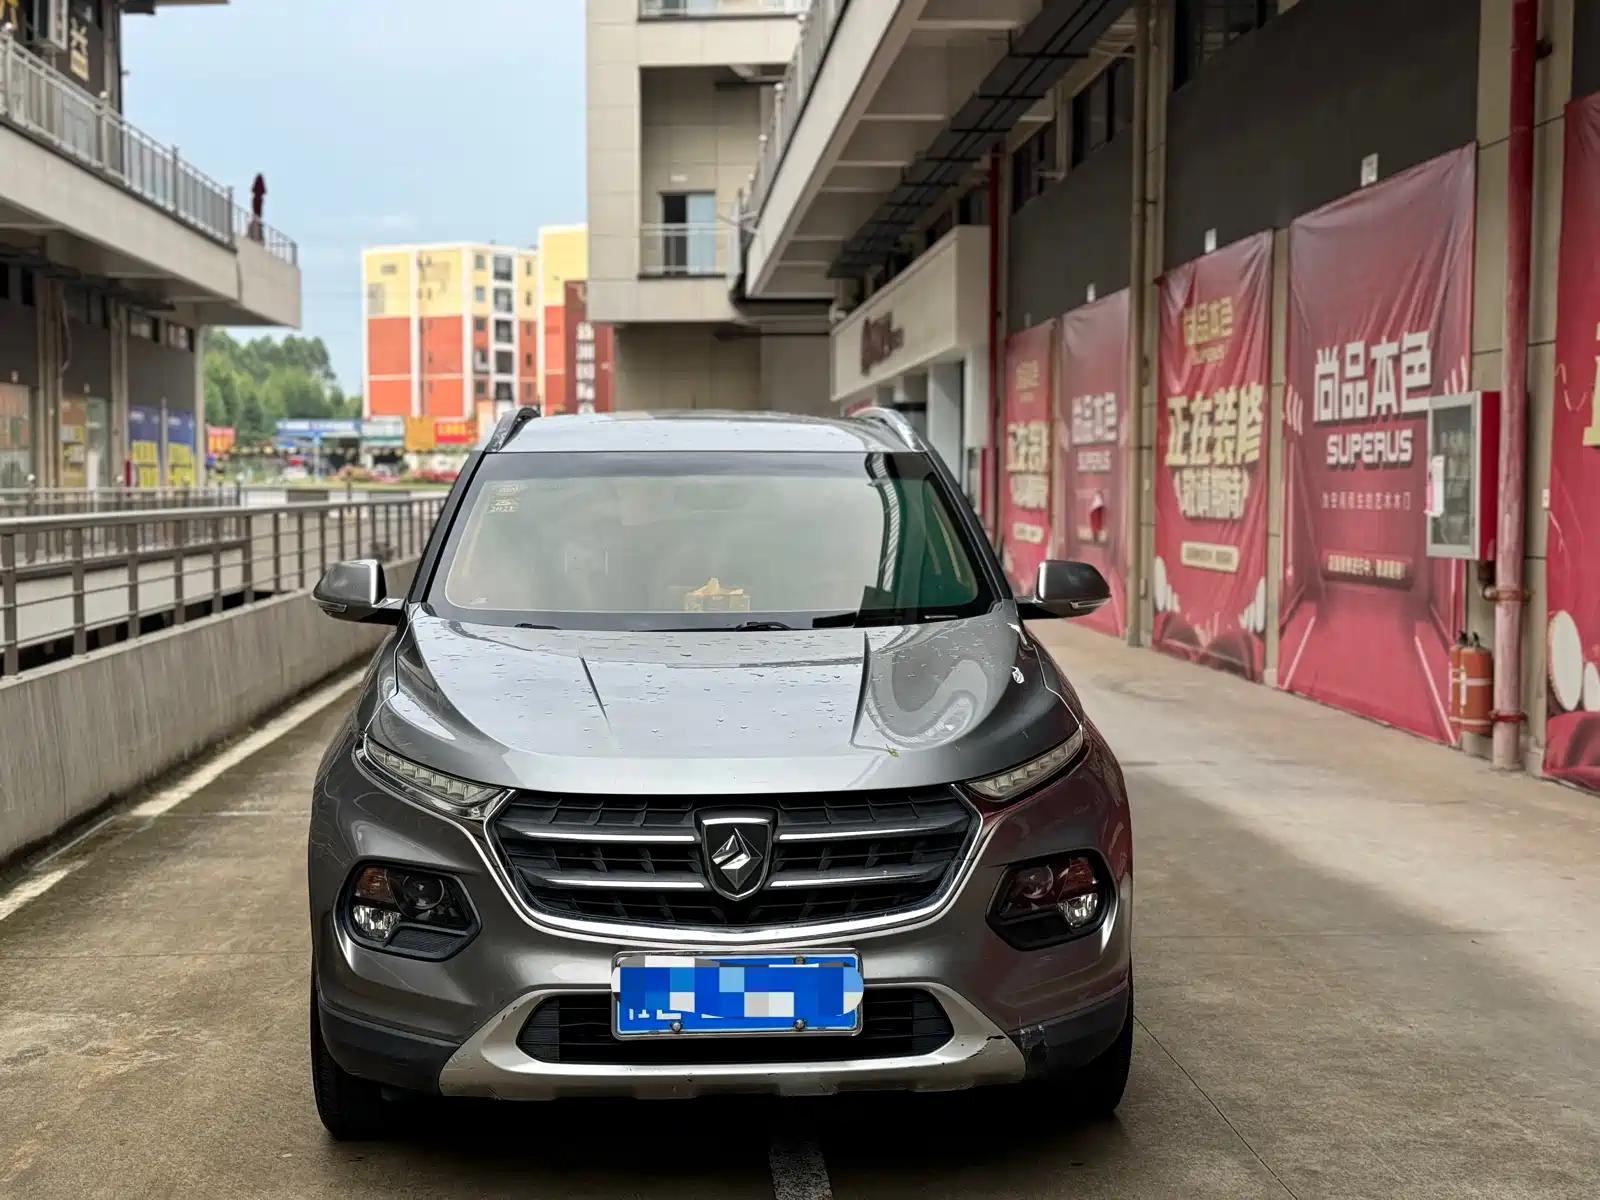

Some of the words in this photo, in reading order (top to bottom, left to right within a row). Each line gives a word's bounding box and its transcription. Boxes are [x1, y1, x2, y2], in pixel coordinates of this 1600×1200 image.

[1313, 331, 1431, 421] 尚品本色
[1165, 382, 1264, 467] 正在装修
[1326, 428, 1412, 465] SUPERUS
